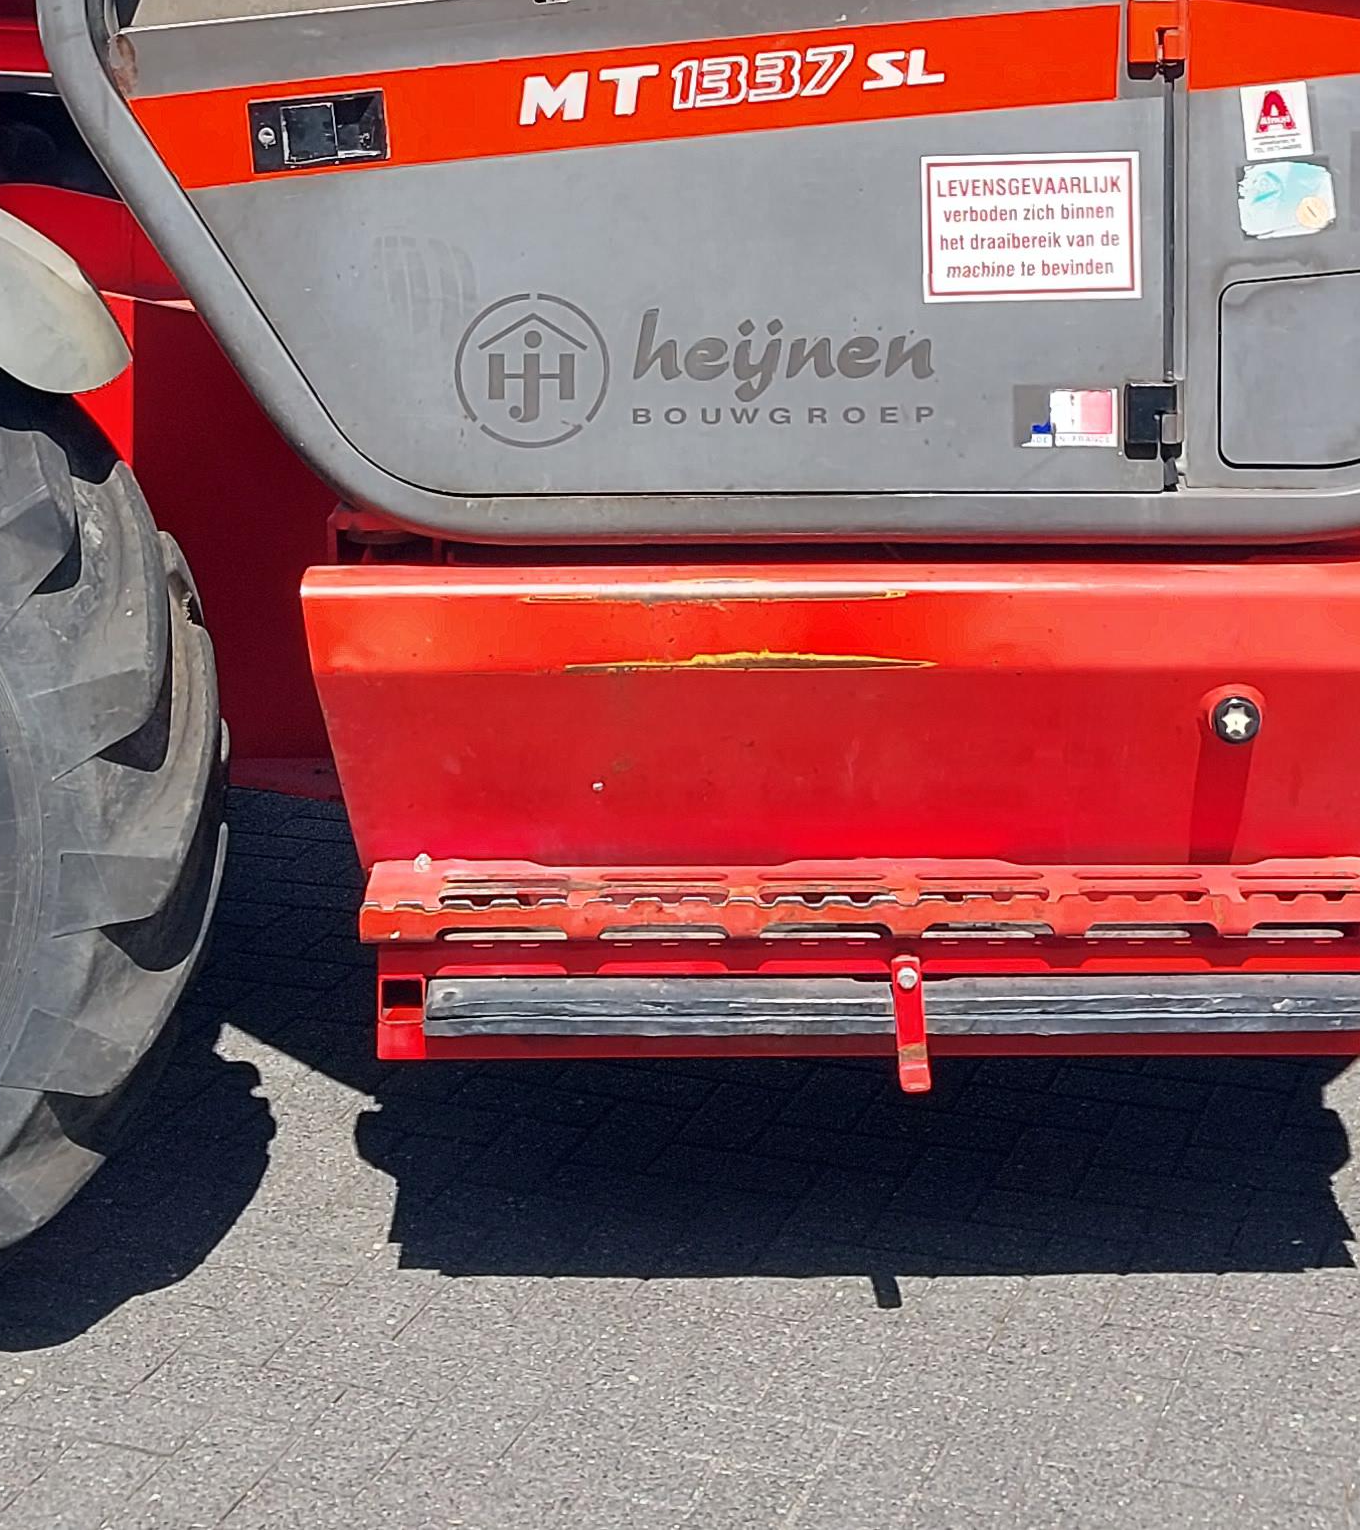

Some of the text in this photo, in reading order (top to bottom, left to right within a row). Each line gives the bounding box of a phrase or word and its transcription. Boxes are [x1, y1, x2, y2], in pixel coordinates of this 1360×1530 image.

[672, 44, 855, 110] 1337
[862, 49, 945, 90] SL
[937, 175, 1121, 197] LEVENSGEVAARLIJK
[943, 203, 1114, 223] verboden zich binnen
[940, 230, 1120, 251] het draaibereik van de
[946, 258, 1114, 279] machine te bevinden
[632, 406, 935, 425] BOUWGROEP
